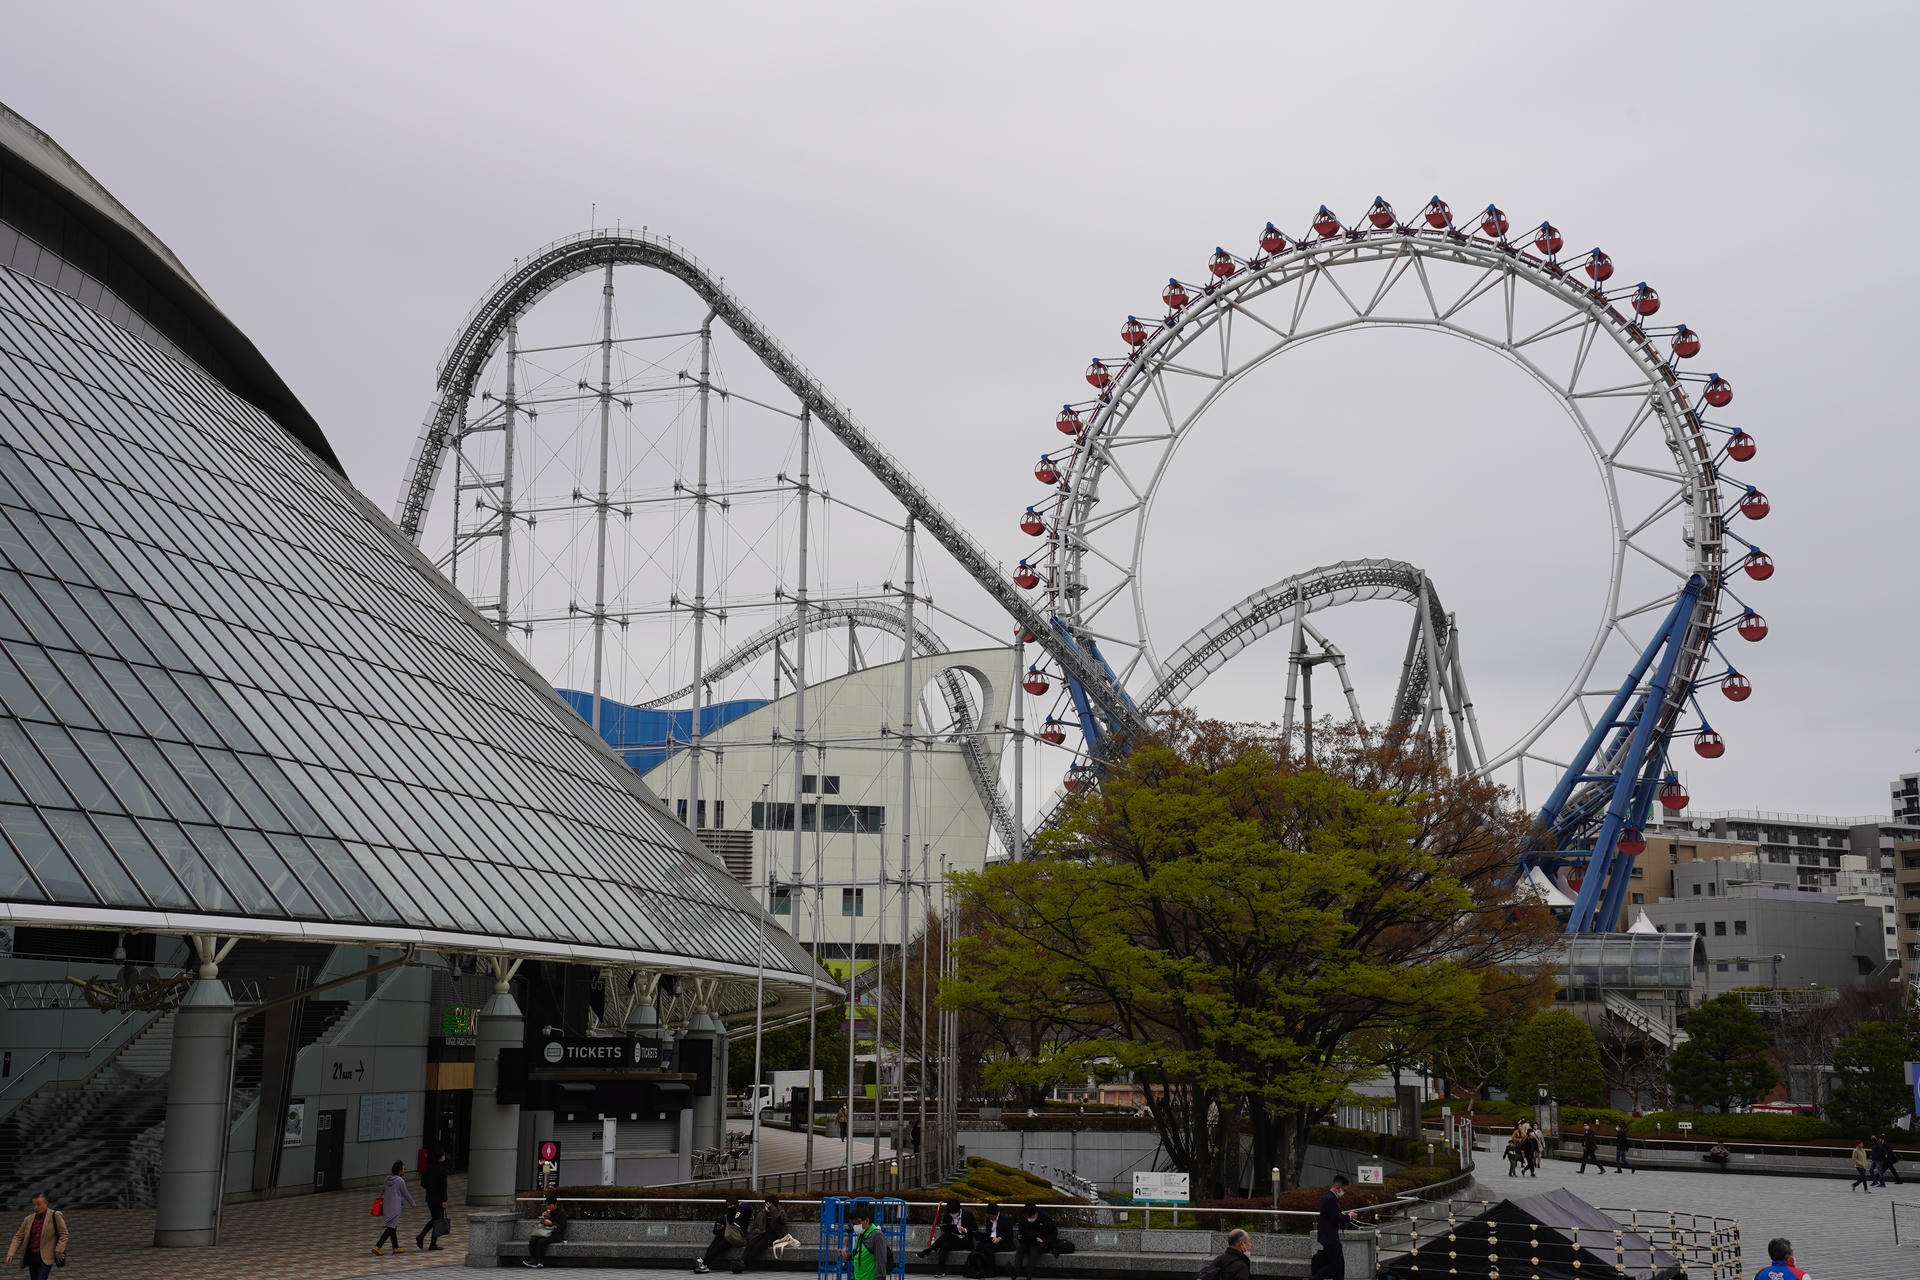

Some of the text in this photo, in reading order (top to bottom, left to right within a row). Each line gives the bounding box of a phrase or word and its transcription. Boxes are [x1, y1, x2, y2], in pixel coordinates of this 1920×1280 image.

[567, 1046, 622, 1059] TICKETS
[641, 1047, 658, 1059] TICKETS
[332, 1062, 343, 1080] 21
